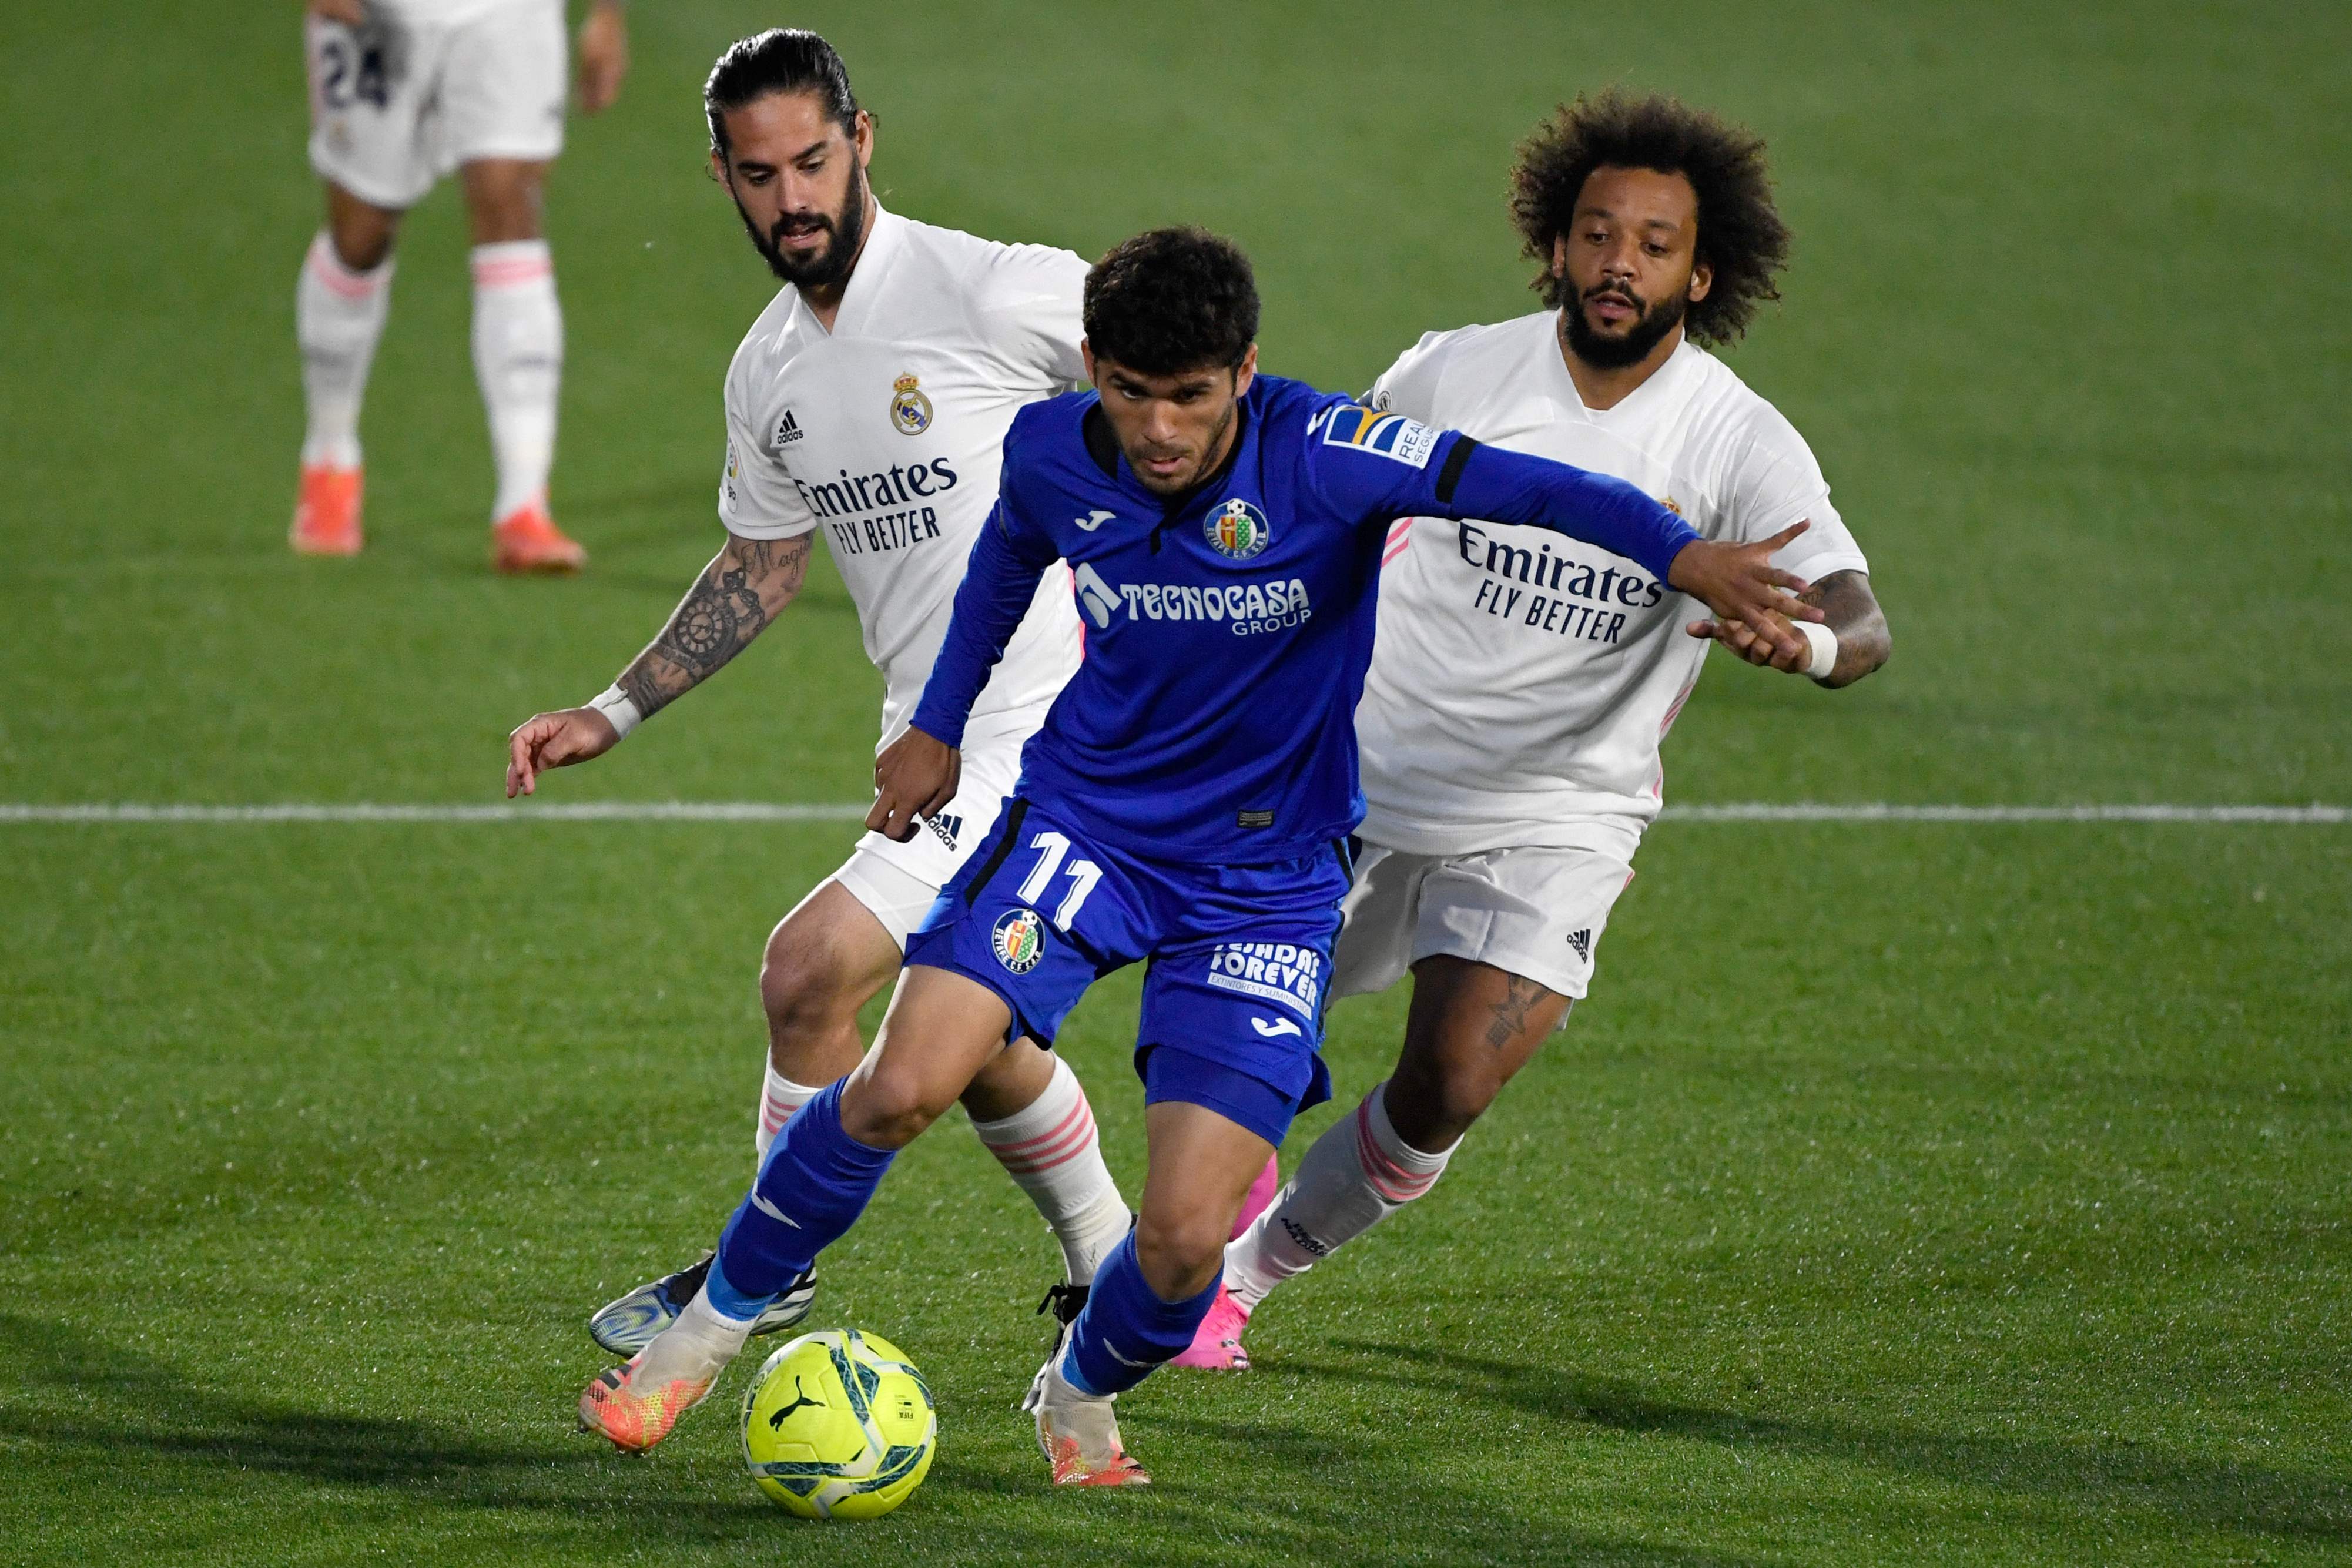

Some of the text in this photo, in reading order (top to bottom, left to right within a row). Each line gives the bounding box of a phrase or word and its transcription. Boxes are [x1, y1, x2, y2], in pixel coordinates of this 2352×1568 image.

[321, 39, 390, 108] 24
[777, 430, 803, 444] adidas
[794, 457, 957, 517] Emirates
[832, 521, 863, 554] FLY
[863, 507, 941, 552] BETTER
[1459, 521, 1663, 608] Emirates
[1120, 579, 1309, 621] TECNOCASA
[1475, 578, 1522, 618] FLY
[1232, 609, 1312, 636] GROUP
[1525, 595, 1626, 644] BETTER
[928, 819, 957, 852] didas
[1016, 832, 1103, 933] 11
[994, 928, 1010, 963] GETAFE
[1210, 951, 1317, 1007] FOREVER
[1211, 975, 1255, 992] EXTINTORES
